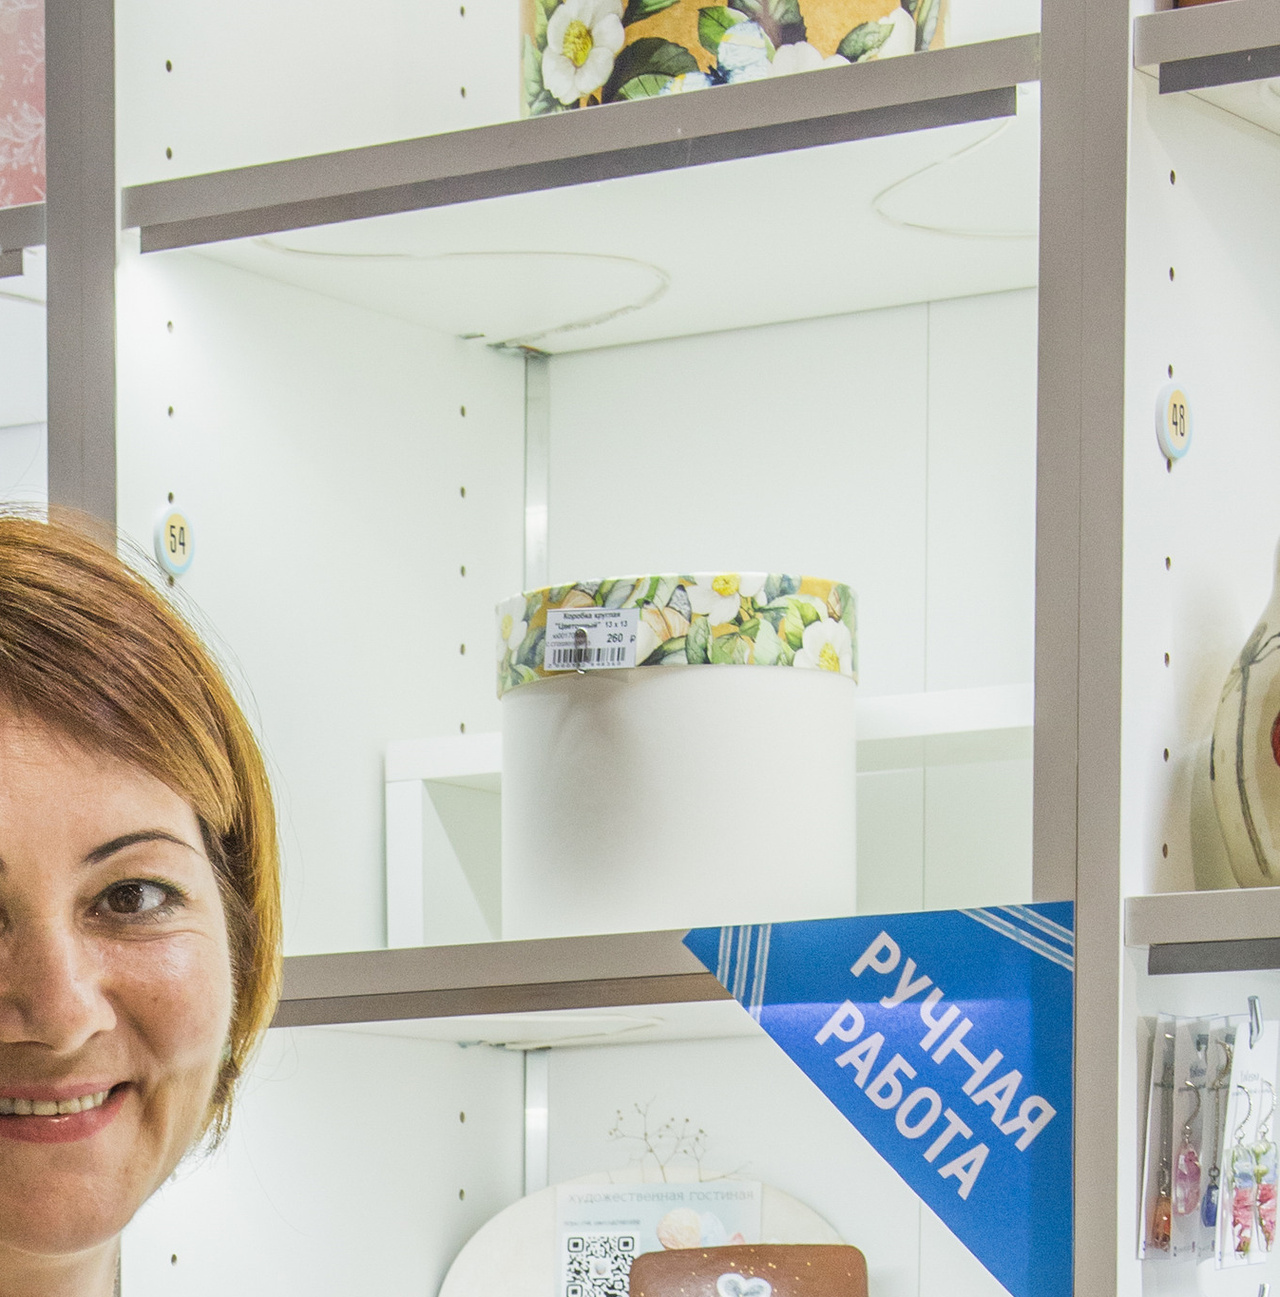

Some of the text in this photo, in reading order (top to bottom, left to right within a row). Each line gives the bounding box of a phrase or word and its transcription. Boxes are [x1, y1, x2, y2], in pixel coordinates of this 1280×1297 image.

[1172, 403, 1186, 437] 48
[169, 524, 186, 555] 54
[606, 633, 624, 643] 260
[850, 930, 1057, 1151] РУЧНАЯ
[814, 999, 990, 1201] РАБОТА
[568, 1189, 754, 1204] художественная гостиная
